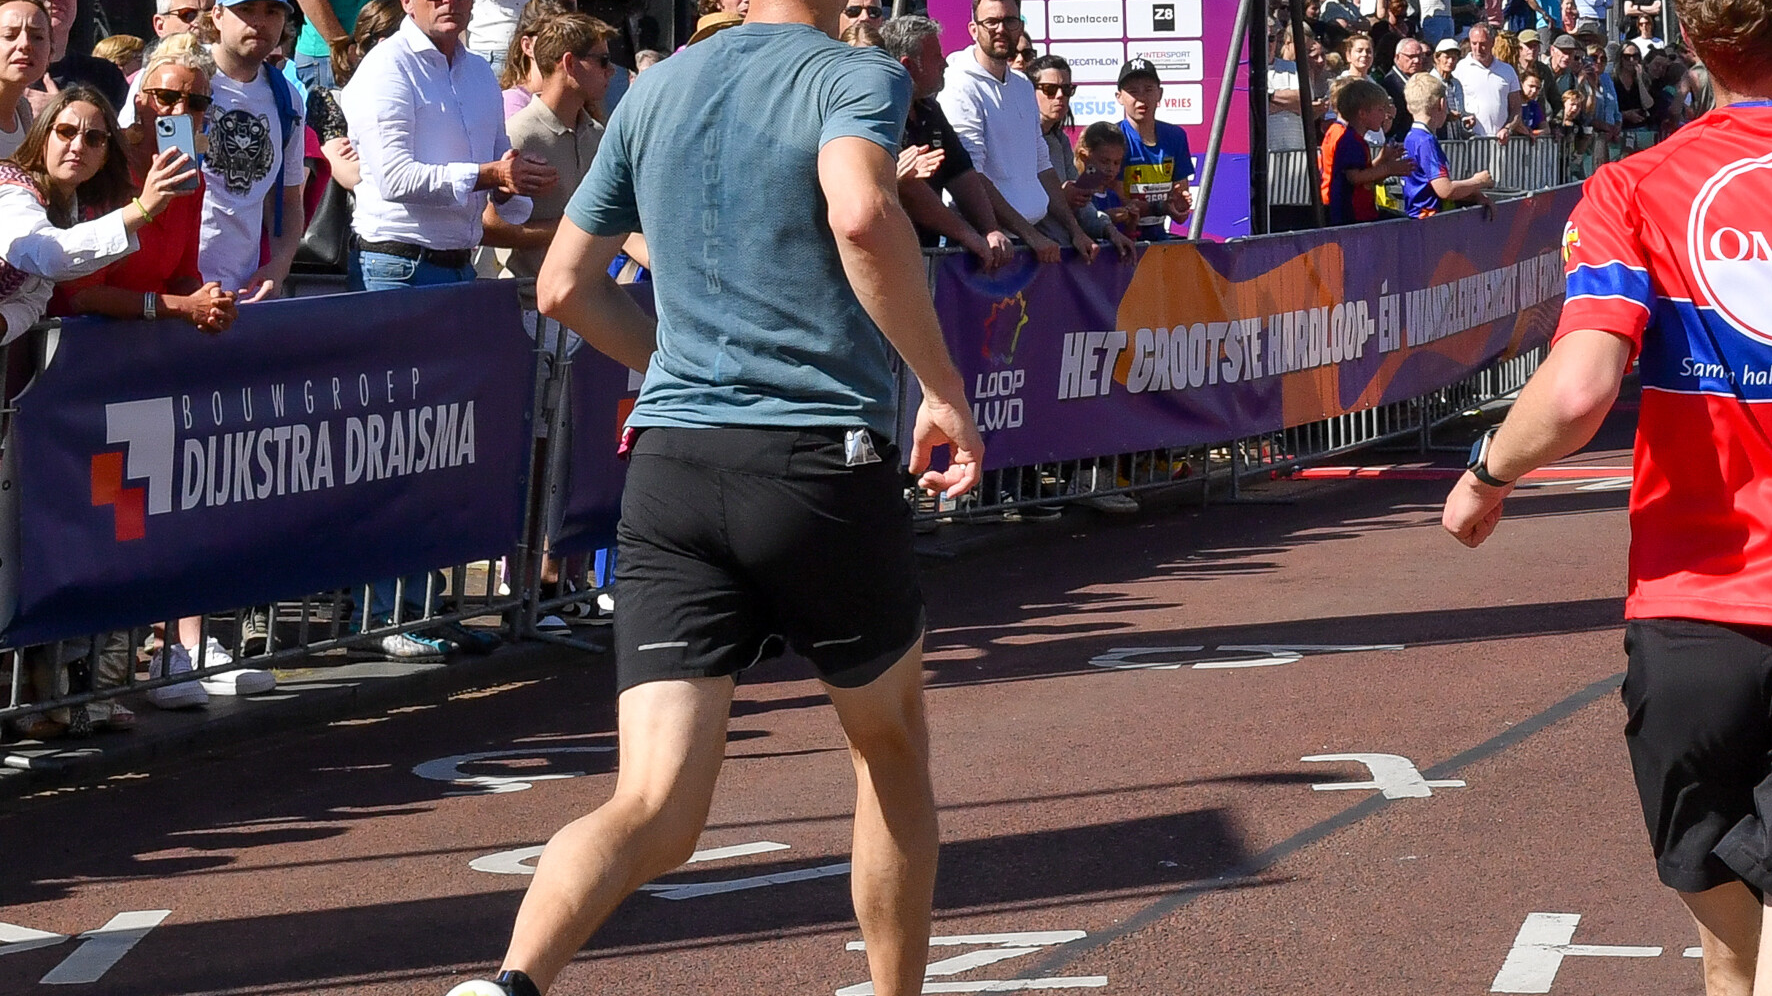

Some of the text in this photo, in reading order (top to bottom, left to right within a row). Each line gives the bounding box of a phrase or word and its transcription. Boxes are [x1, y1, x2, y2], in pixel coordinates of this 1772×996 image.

[1154, 8, 1174, 21] Z8
[1070, 101, 1117, 115] RSUS
[1164, 98, 1192, 108] VRIES
[1058, 330, 1127, 400] HET
[1126, 317, 1262, 394] GROOTSTE
[975, 369, 1025, 399] LOOP
[973, 397, 1024, 432] LWD
[181, 400, 476, 511] DIJKSTRA DRAISMA
